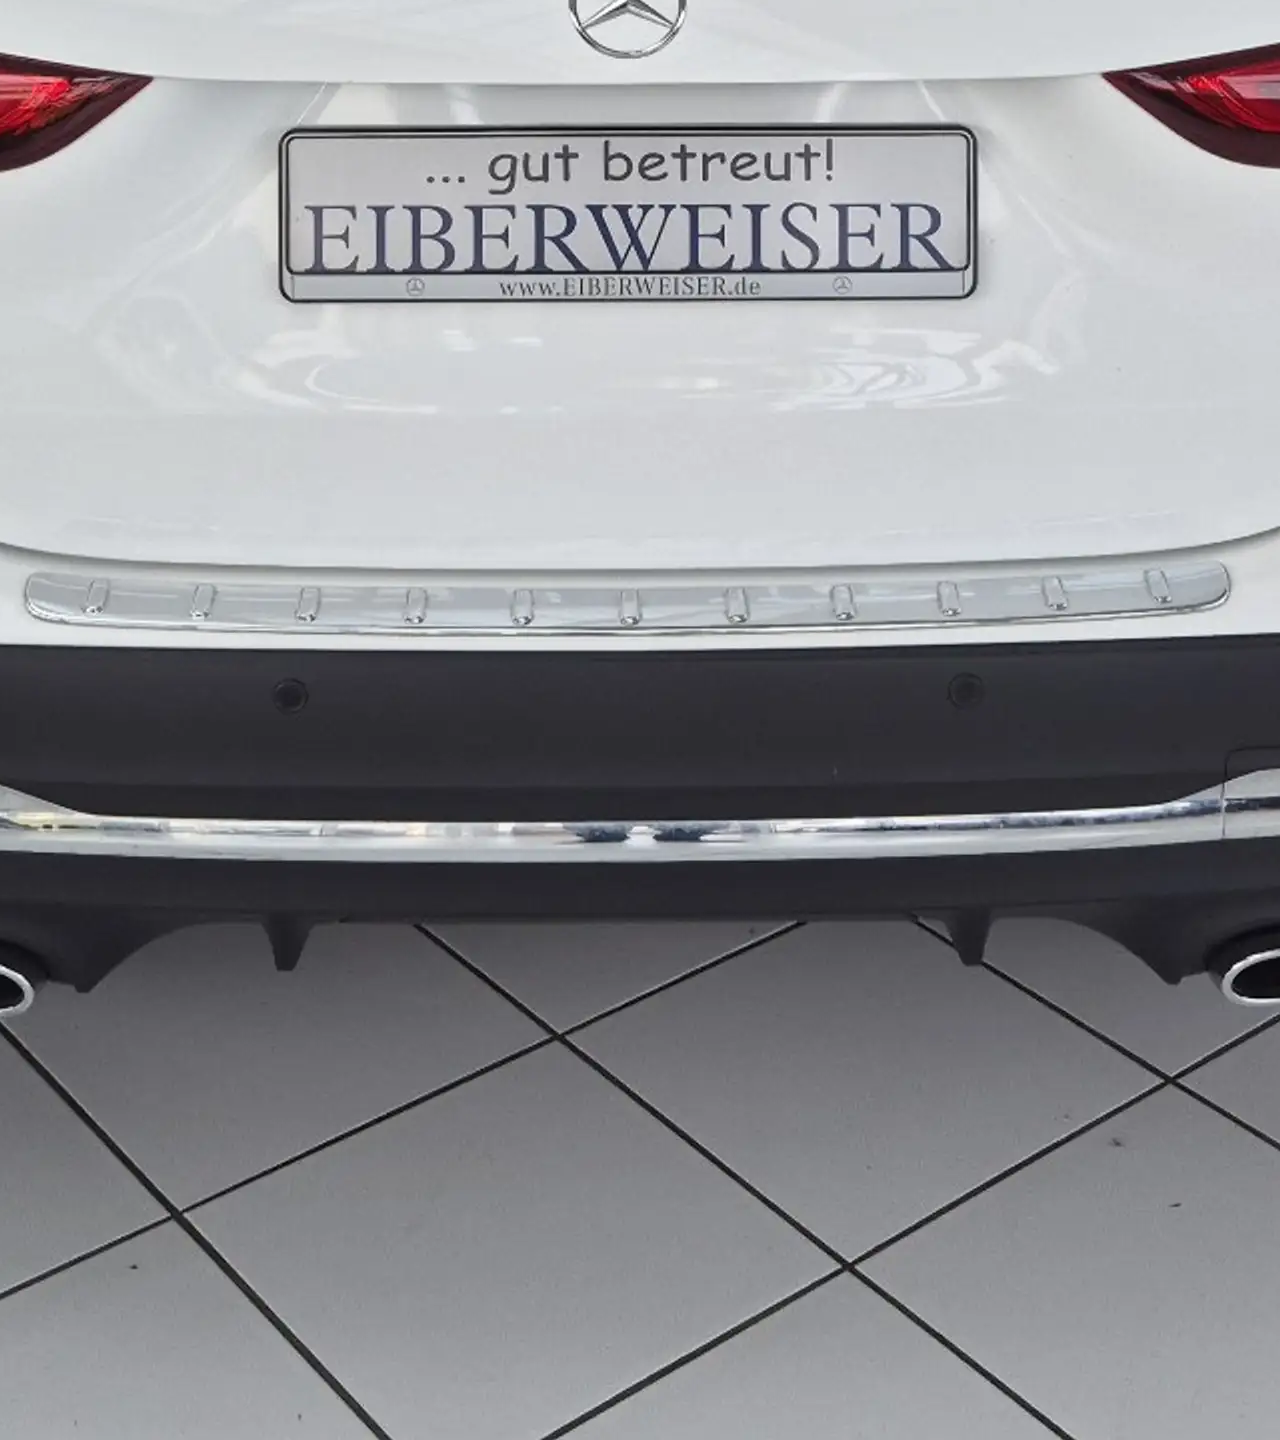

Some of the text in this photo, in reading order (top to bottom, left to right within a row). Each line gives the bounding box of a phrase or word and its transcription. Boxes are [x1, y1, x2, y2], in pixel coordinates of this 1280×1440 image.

[488, 143, 579, 195] gut
[603, 139, 835, 182] betreut!
[304, 202, 964, 273] EIBERWEISER
[499, 276, 761, 298] www.EIBERWEISER.de
